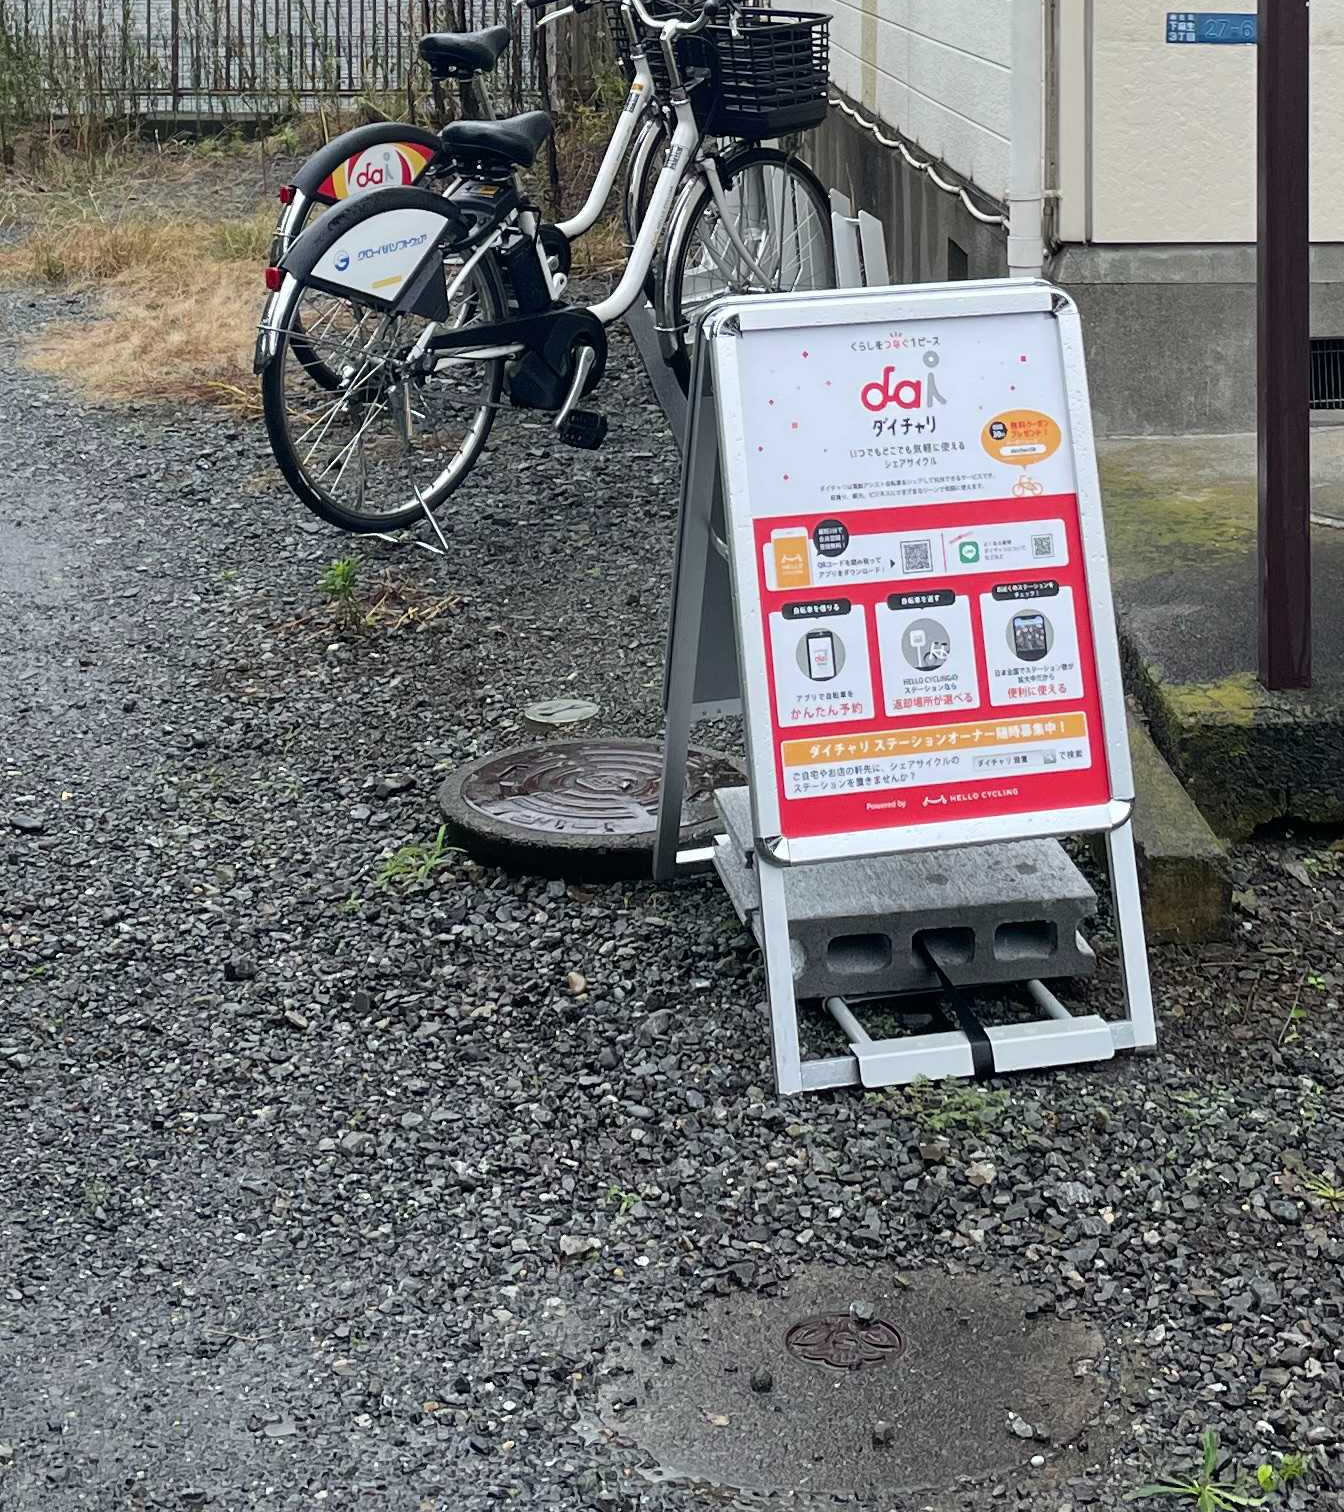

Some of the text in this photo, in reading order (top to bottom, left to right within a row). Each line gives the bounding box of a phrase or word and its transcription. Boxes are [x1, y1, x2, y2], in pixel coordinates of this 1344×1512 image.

[356, 152, 394, 187] dai
[850, 337, 941, 352] くらしをつなぐ1ピース
[861, 350, 947, 412] dai
[873, 415, 936, 437] ダイチャリ
[850, 441, 965, 458] いつでもどこでも気軽に使える
[884, 457, 937, 469] シェアサイクル
[796, 691, 854, 702] アプリで自転車を
[1007, 683, 1067, 699] 便利に使える
[791, 702, 863, 720] かんたん予約
[809, 740, 869, 758] ダイチャリ
[950, 788, 1019, 803] HELLO CYCLING
[866, 800, 896, 811] Powered
